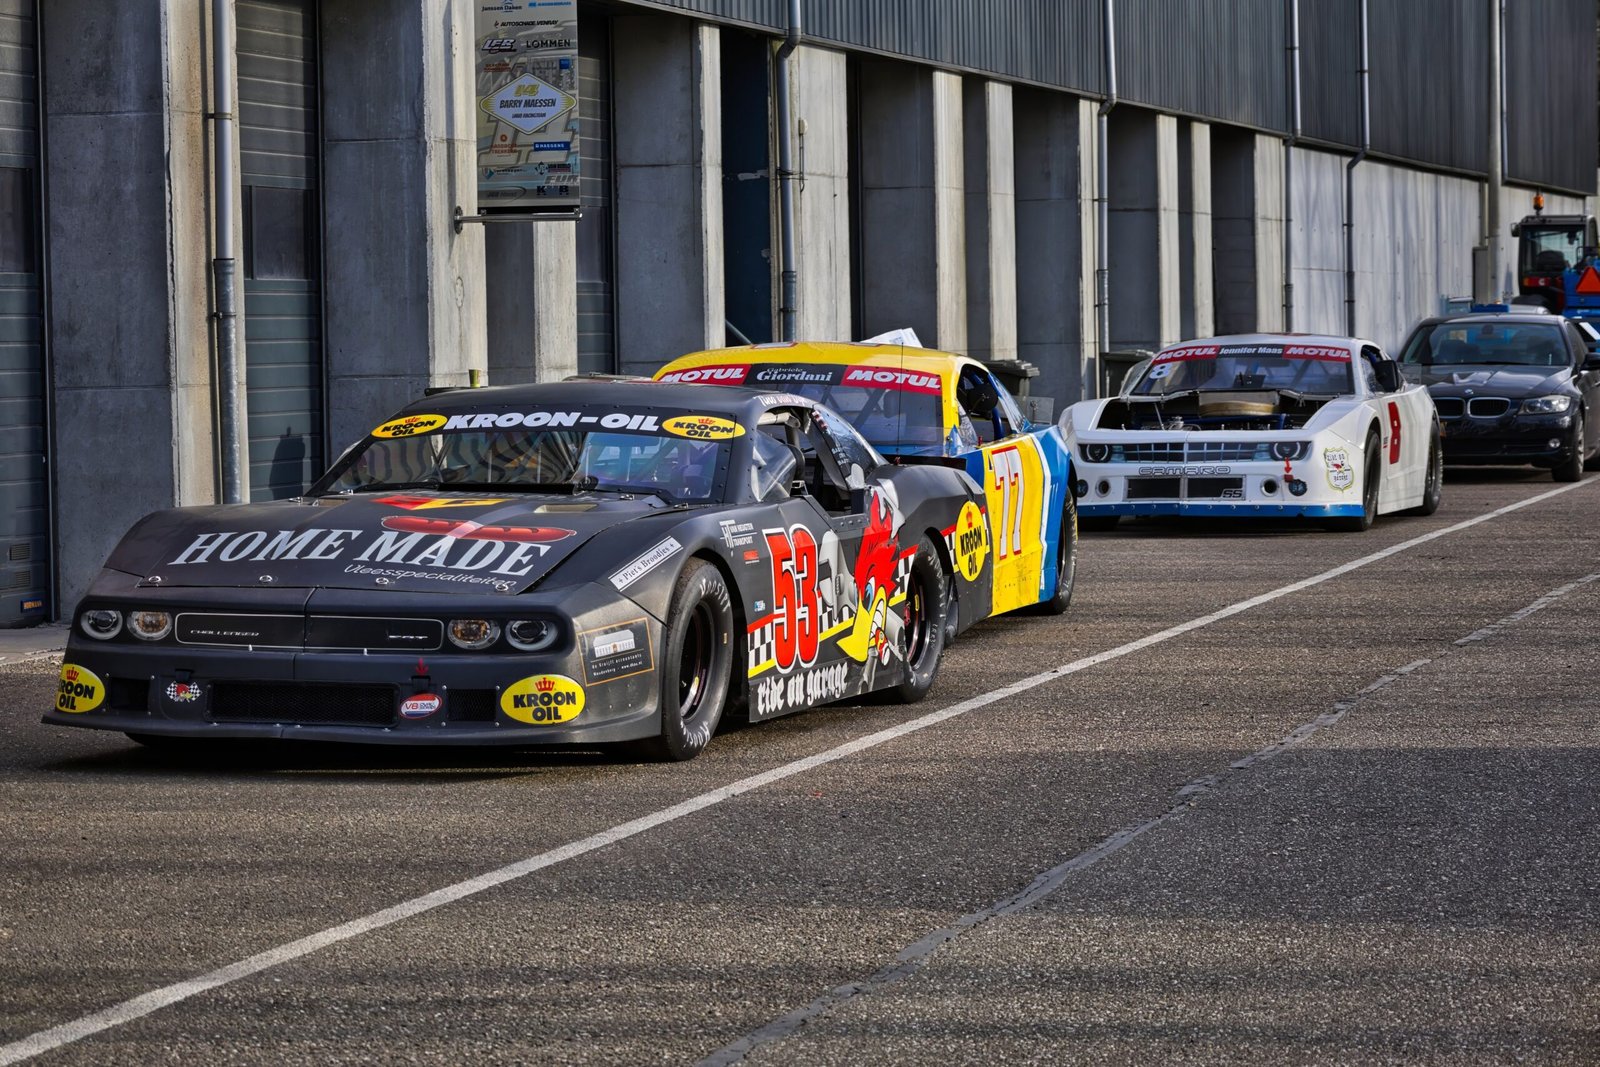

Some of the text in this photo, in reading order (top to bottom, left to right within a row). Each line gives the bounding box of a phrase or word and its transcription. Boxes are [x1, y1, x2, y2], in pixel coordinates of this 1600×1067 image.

[526, 40, 571, 48] LOMMEN
[500, 98, 556, 108] BARRY MAESSEN
[1157, 345, 1351, 360] MOTUL Jennifer Maas MOTUL
[661, 367, 744, 384] MOTUL
[756, 370, 833, 382] Giordani
[847, 368, 941, 389] MOTUL
[1150, 363, 1172, 379] 8
[381, 420, 437, 432] KROON
[443, 412, 661, 431] KROON-OIL
[673, 421, 734, 434] KROON
[391, 428, 415, 436] OIL
[686, 429, 711, 438] OIL
[1388, 401, 1402, 465] 8
[1138, 466, 1231, 476] CAMARO
[1222, 489, 1243, 498] SS
[992, 445, 1025, 561] 77
[960, 525, 983, 556] KROON
[167, 528, 552, 576] HOME MADE
[640, 547, 670, 568] Broodjes
[968, 551, 978, 576] OIL
[762, 523, 820, 675] 53
[60, 679, 95, 700] ROON
[58, 693, 76, 710] OIL
[404, 702, 419, 710] V8
[513, 691, 577, 708] KROON
[532, 706, 562, 721] OIL
